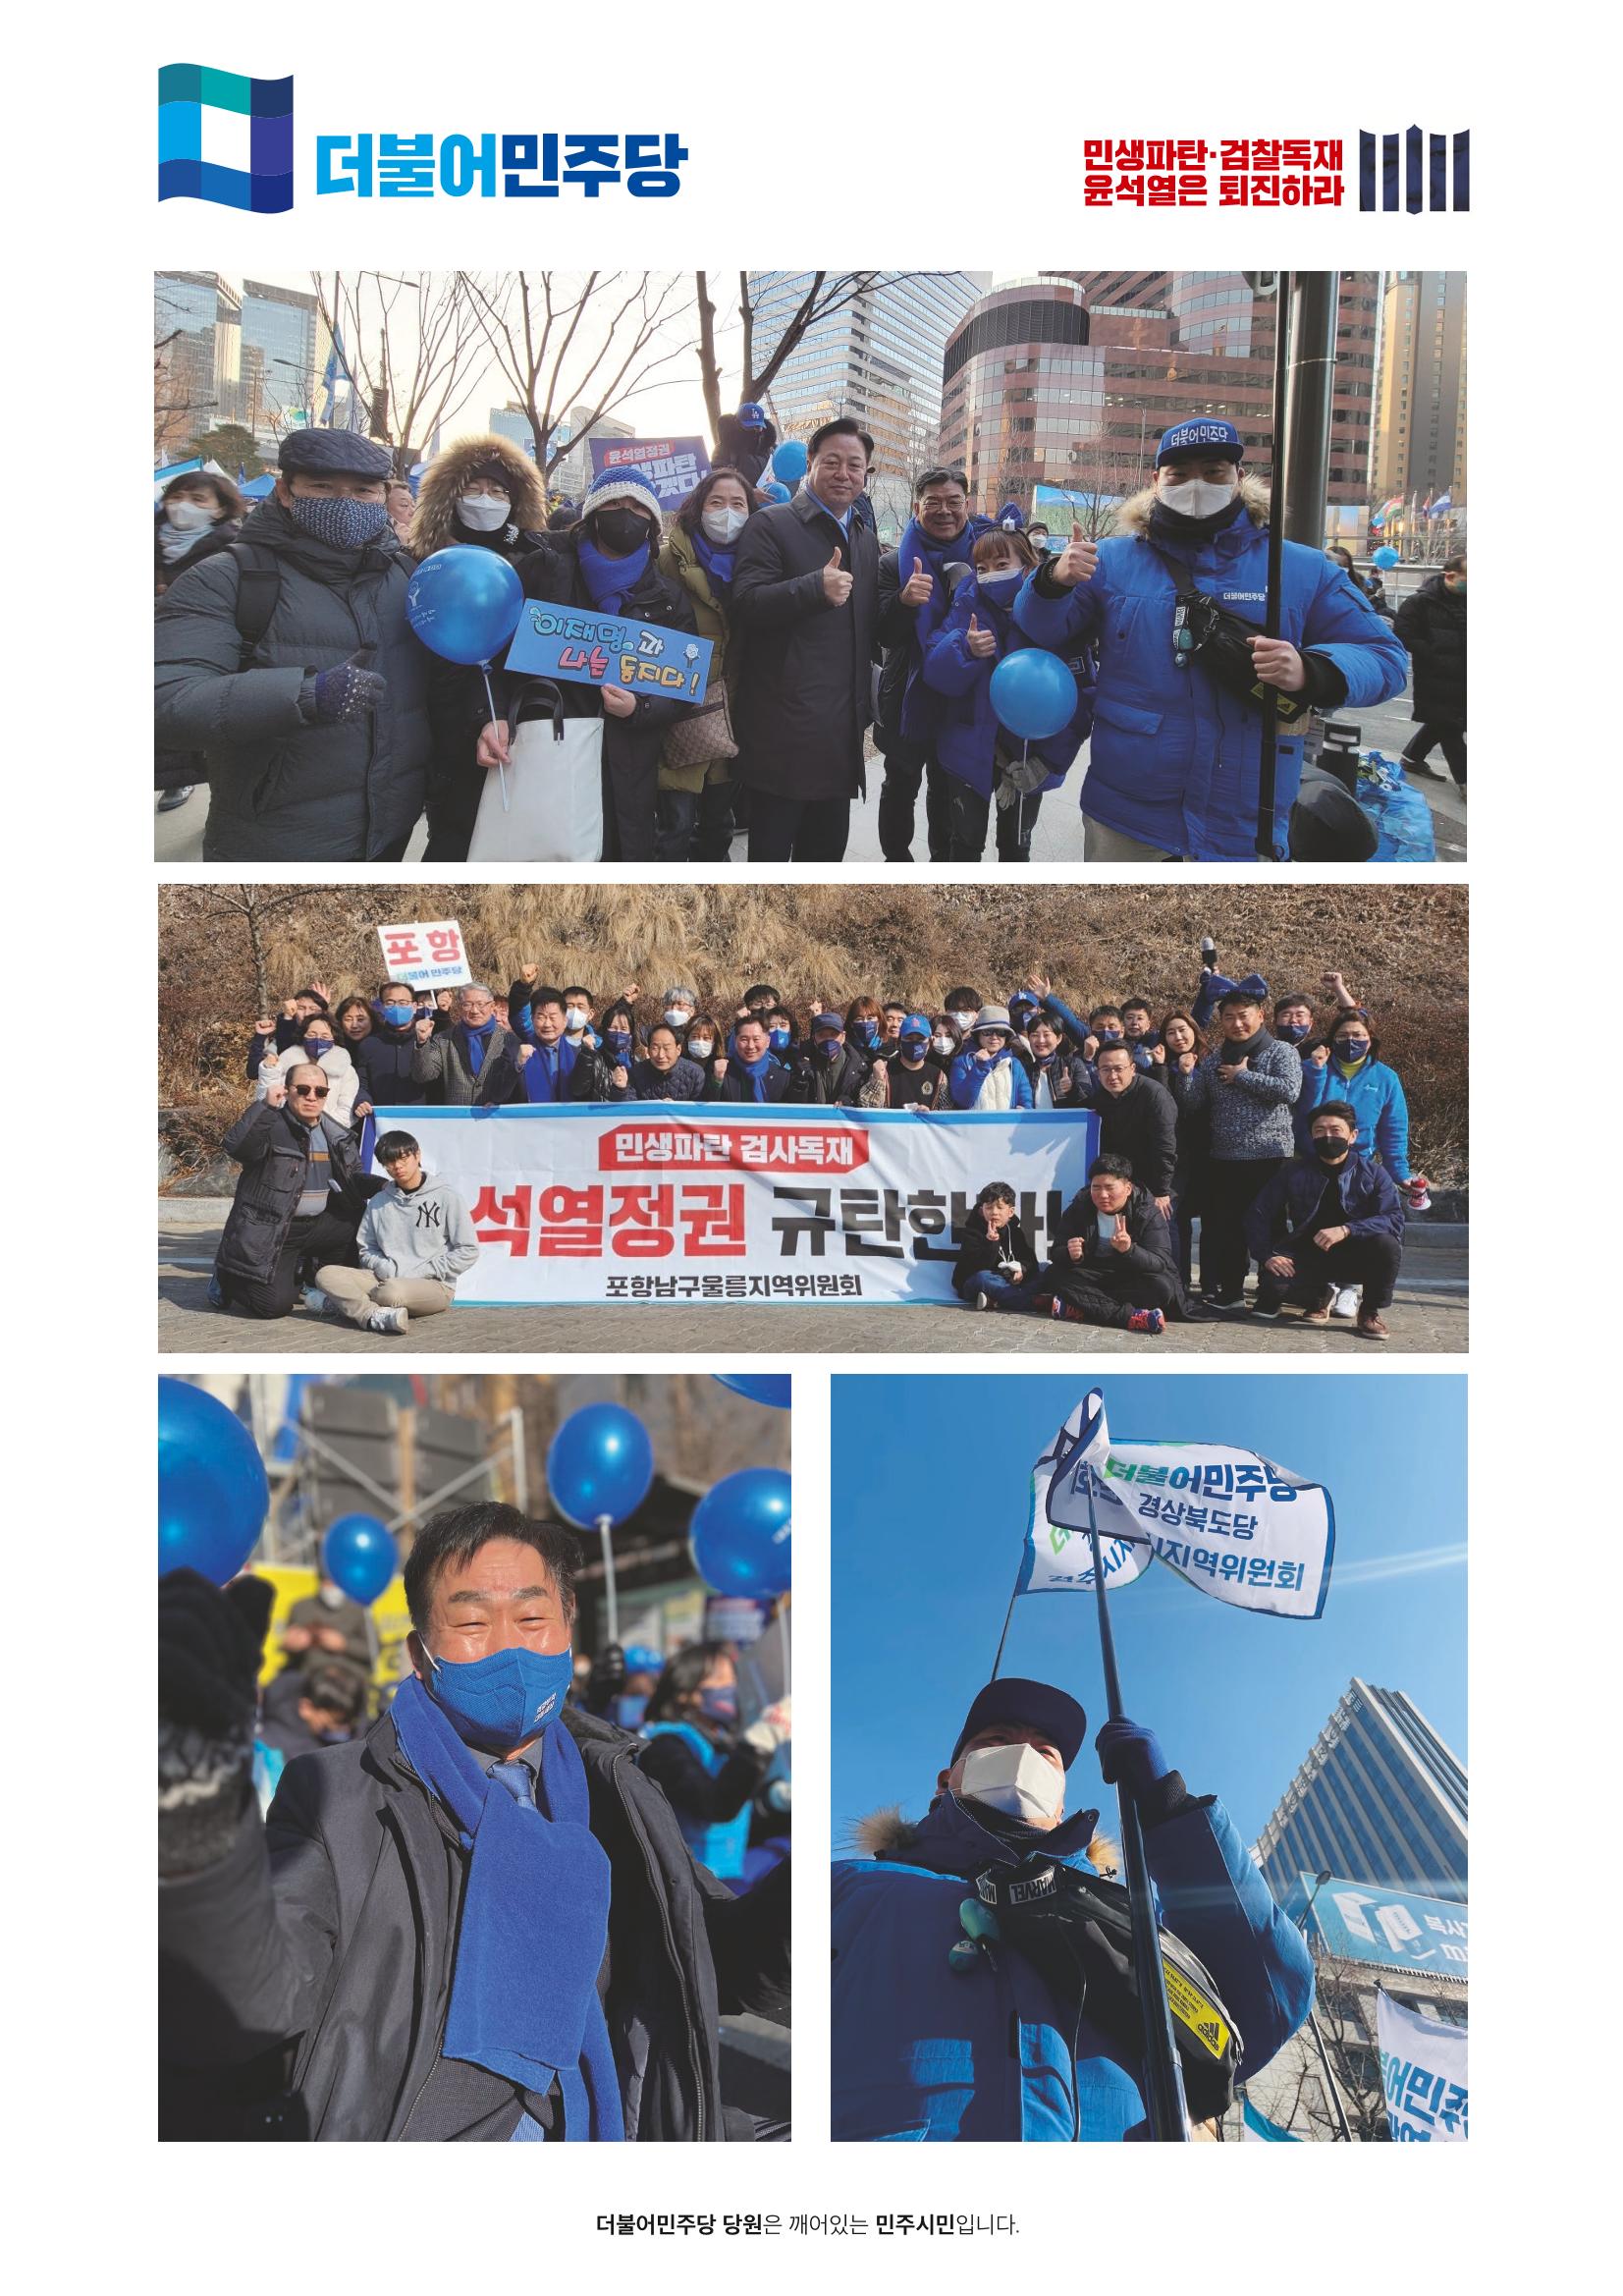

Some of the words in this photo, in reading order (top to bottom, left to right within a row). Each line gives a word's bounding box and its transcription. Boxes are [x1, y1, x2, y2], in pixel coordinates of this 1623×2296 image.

[558, 646, 610, 680] 나는
[615, 1132, 732, 1164] 민생파탄
[739, 1134, 854, 1167] 검사독재
[605, 1275, 863, 1298] 포항남구울릉지역위원회
[1137, 1492, 1259, 1541] 경상북도당
[1424, 1914, 1469, 1940] 복사
